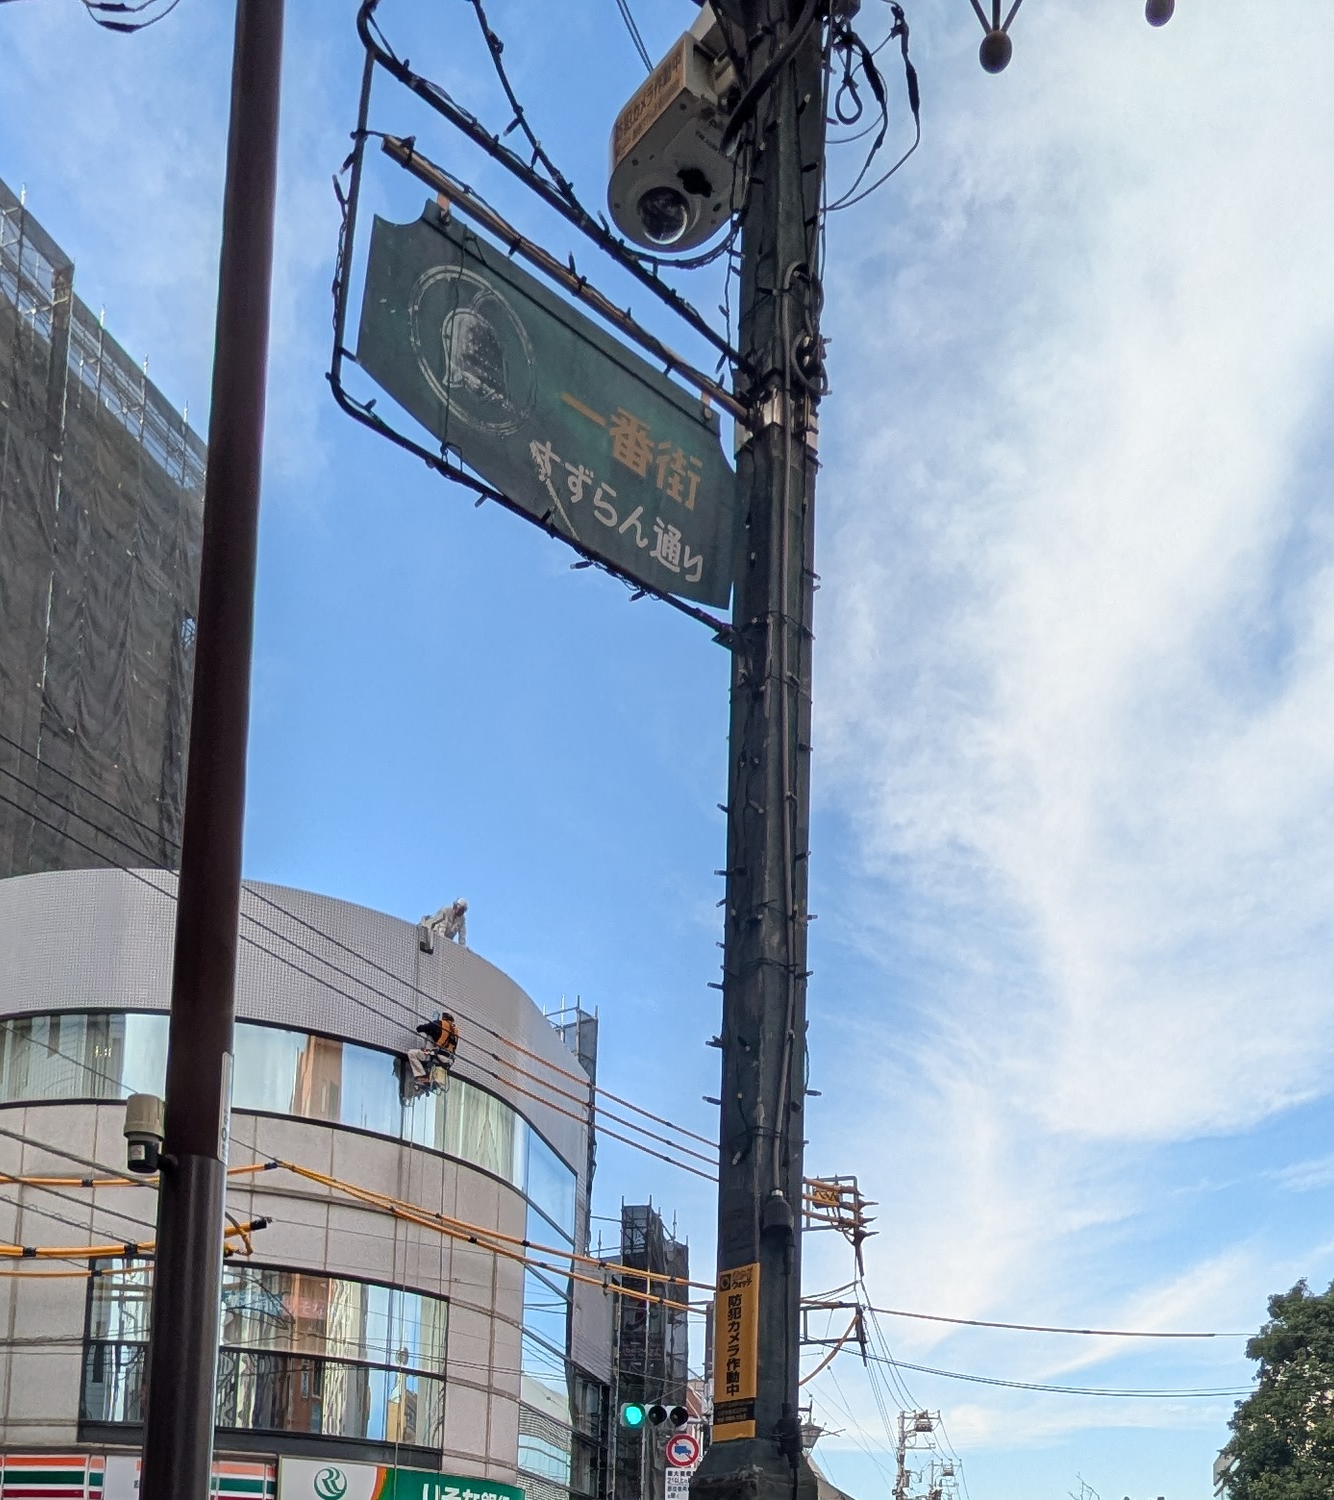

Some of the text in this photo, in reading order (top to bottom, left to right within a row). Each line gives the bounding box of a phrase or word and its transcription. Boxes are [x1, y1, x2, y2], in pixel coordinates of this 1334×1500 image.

[528, 437, 706, 584] すずらん通り
[560, 390, 705, 512] 一番街
[725, 1293, 743, 1397] 防犯カメラ作動中
